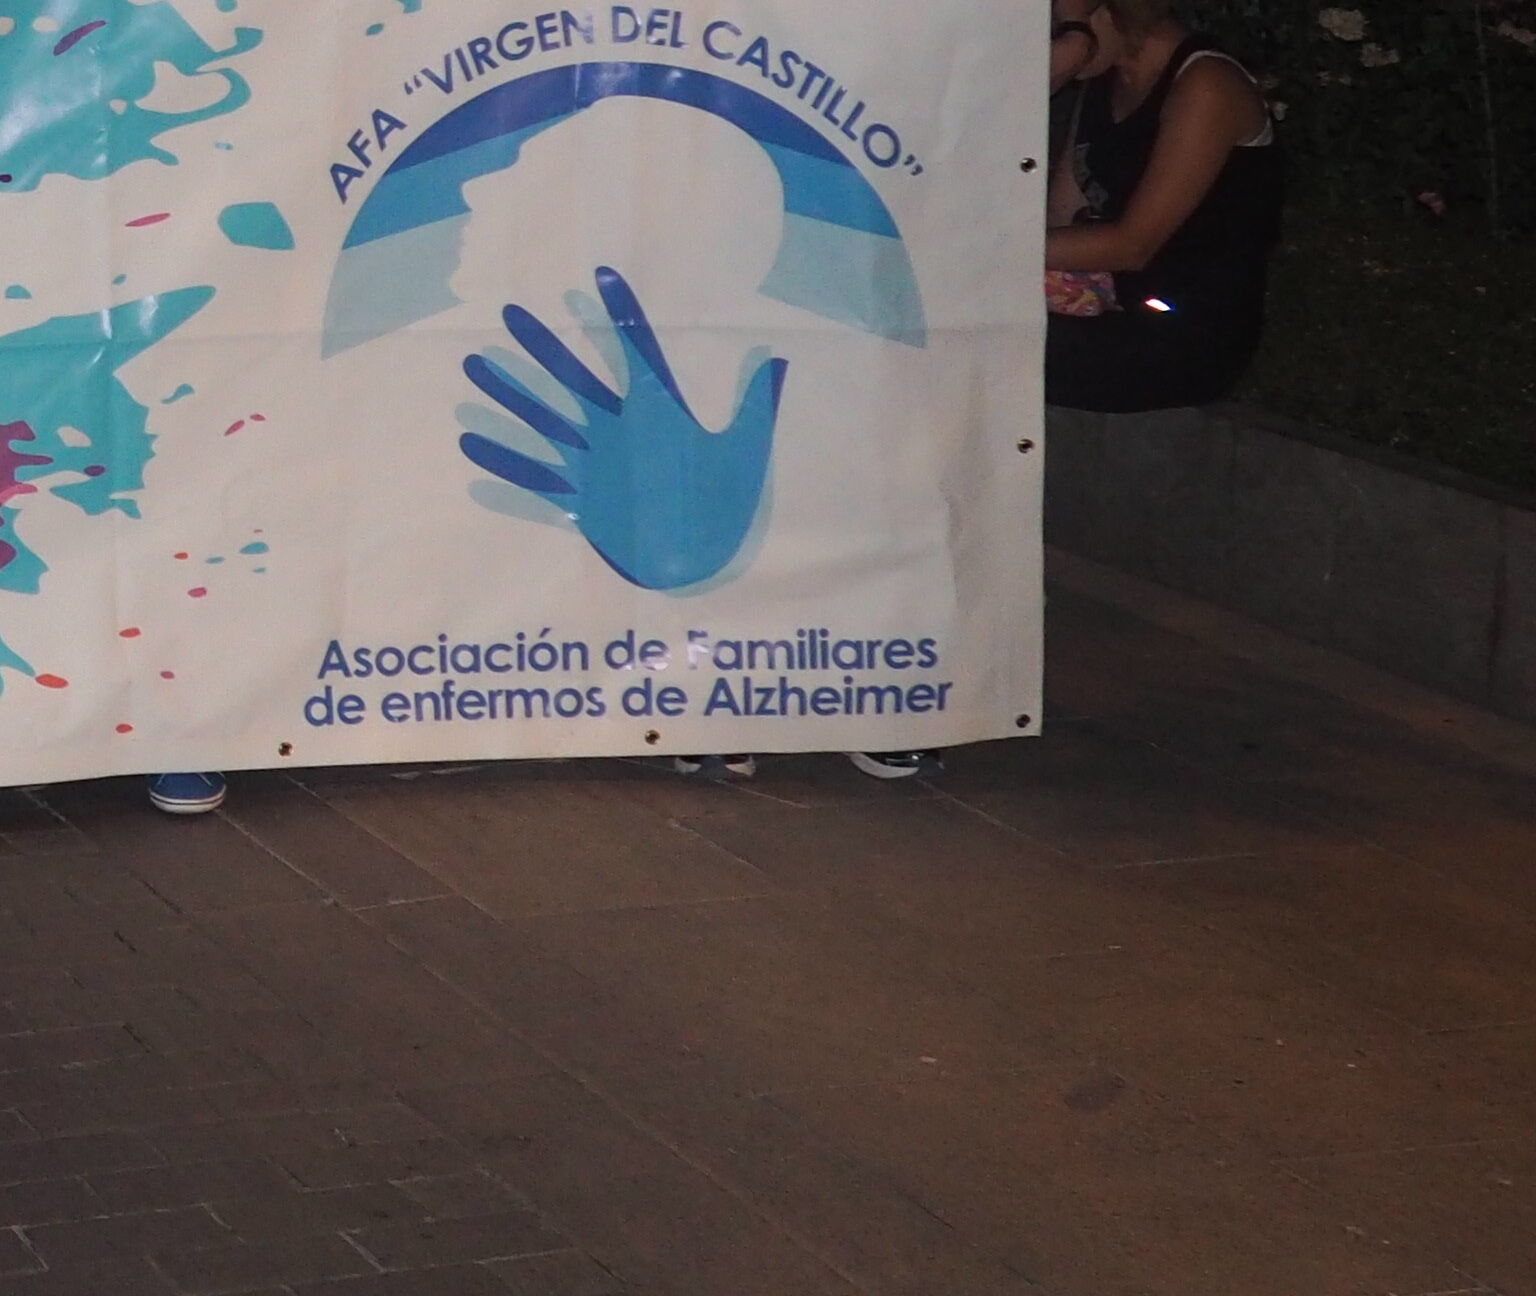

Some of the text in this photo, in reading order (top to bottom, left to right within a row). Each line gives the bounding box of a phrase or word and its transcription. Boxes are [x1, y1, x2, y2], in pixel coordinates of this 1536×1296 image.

[328, 108, 407, 204] AFA
[611, 6, 688, 48] DEL
[317, 628, 938, 679] Asociación de Familiares
[304, 675, 953, 726] de enfermos de Alzheimer
